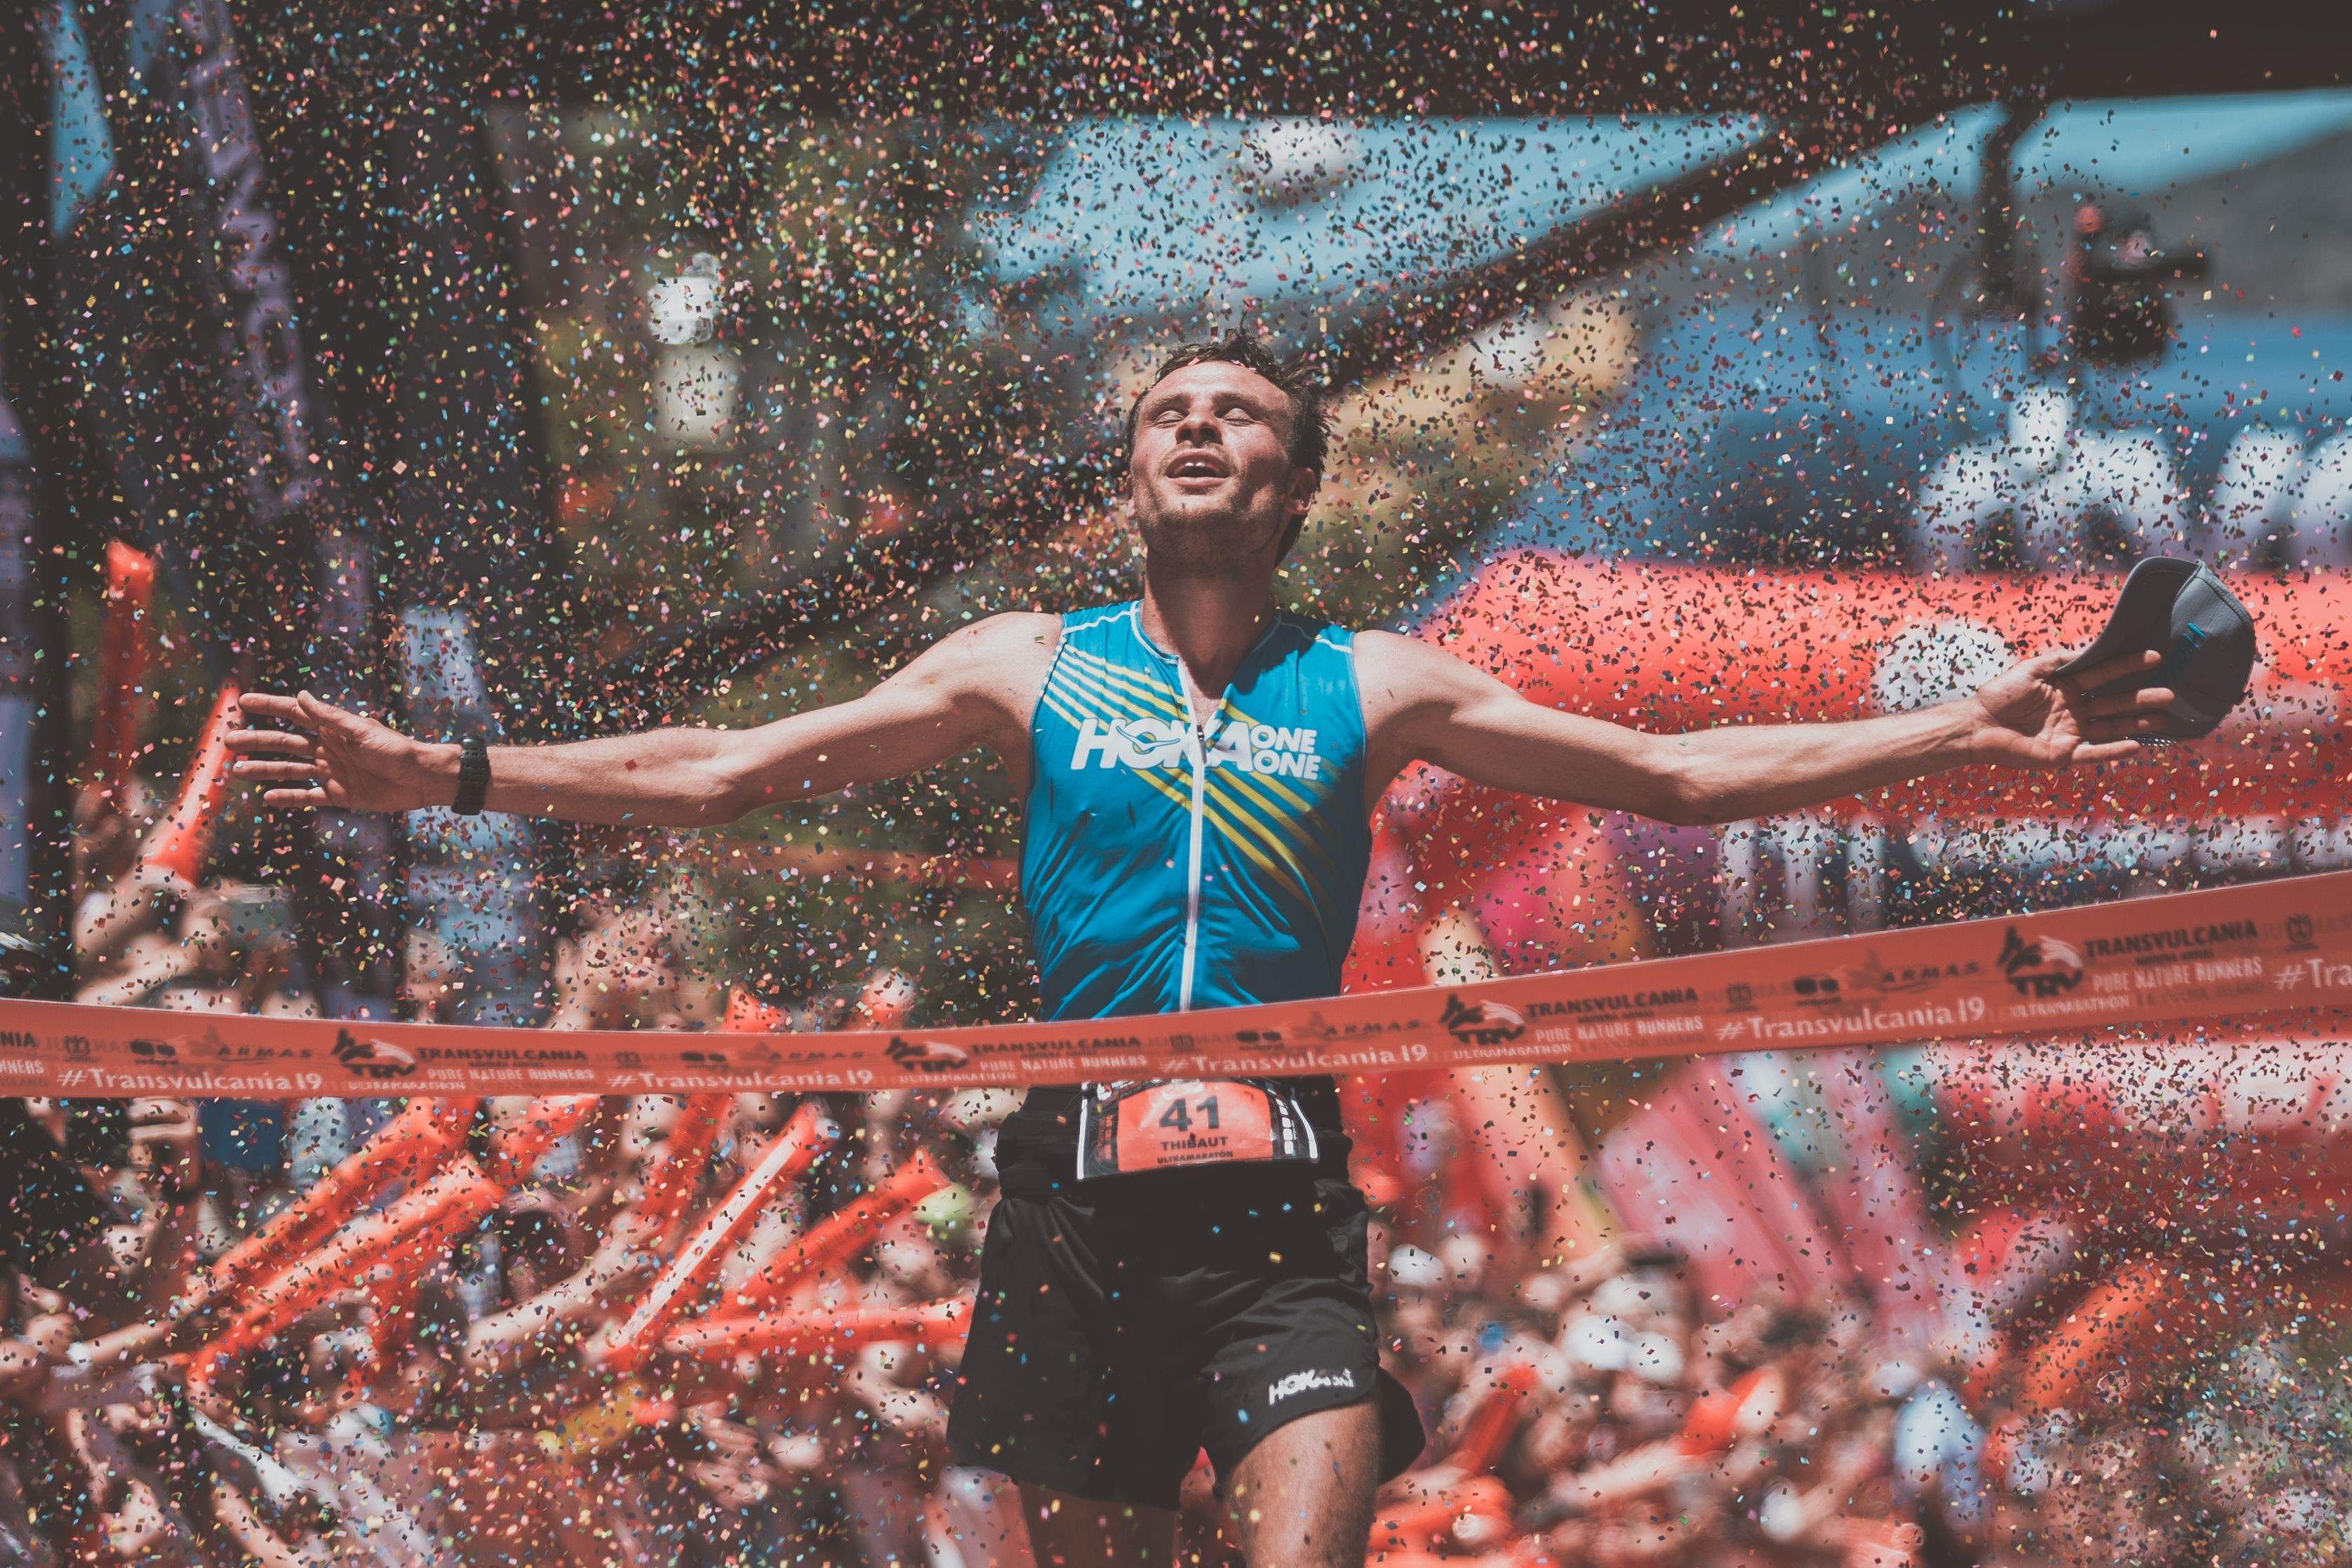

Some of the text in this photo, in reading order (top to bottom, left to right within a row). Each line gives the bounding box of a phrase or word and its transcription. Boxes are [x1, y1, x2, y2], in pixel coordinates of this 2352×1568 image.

[1070, 717, 1317, 771] HOKA ONE
[1252, 752, 1321, 779] ONE
[2084, 920, 2258, 958] TRANSVULCANIA
[2092, 973, 2130, 993] PURE
[2134, 965, 2191, 990] NATURE
[2195, 957, 2262, 982] RUNNERS
[1525, 986, 1699, 1018] TRANSVULCANIA
[1535, 1016, 1704, 1043] PURE NATURE RUNNERS
[417, 1047, 588, 1061] TRANSVULCANIA
[971, 1035, 1142, 1054] TRANSVULCANIA
[0, 1059, 44, 1076] NNERS
[427, 1068, 595, 1081] PURE NATURE RUNNERS
[980, 1055, 1148, 1072] PURE NATURE RUNNERS
[1158, 1095, 1220, 1132] 41
[1161, 1135, 1229, 1151] THIBAUT
